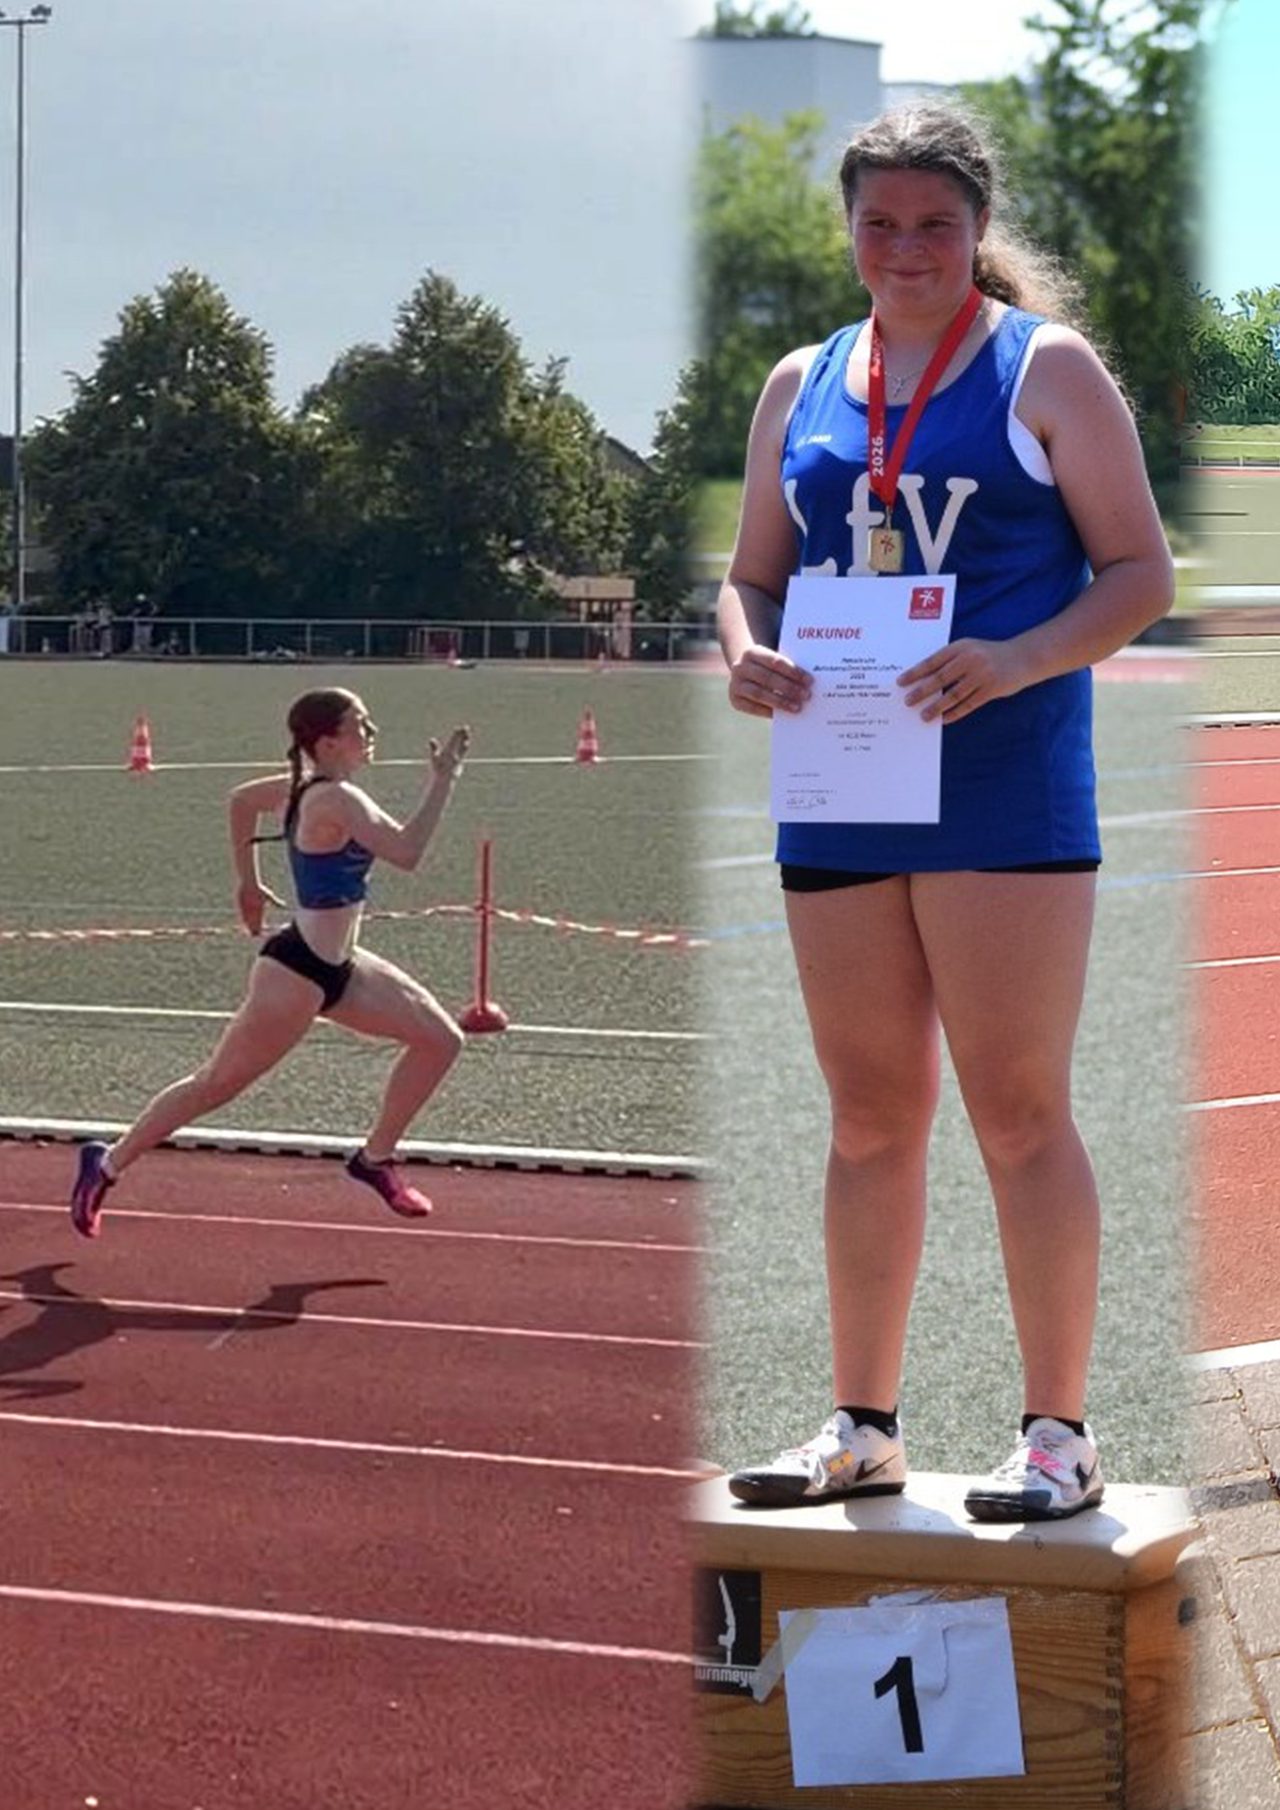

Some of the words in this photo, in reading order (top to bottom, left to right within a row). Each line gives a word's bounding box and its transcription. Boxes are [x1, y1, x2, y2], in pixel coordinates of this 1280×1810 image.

[872, 435, 884, 477] 2026
[797, 626, 864, 640] URKUNDE
[874, 1656, 924, 1753] 1
